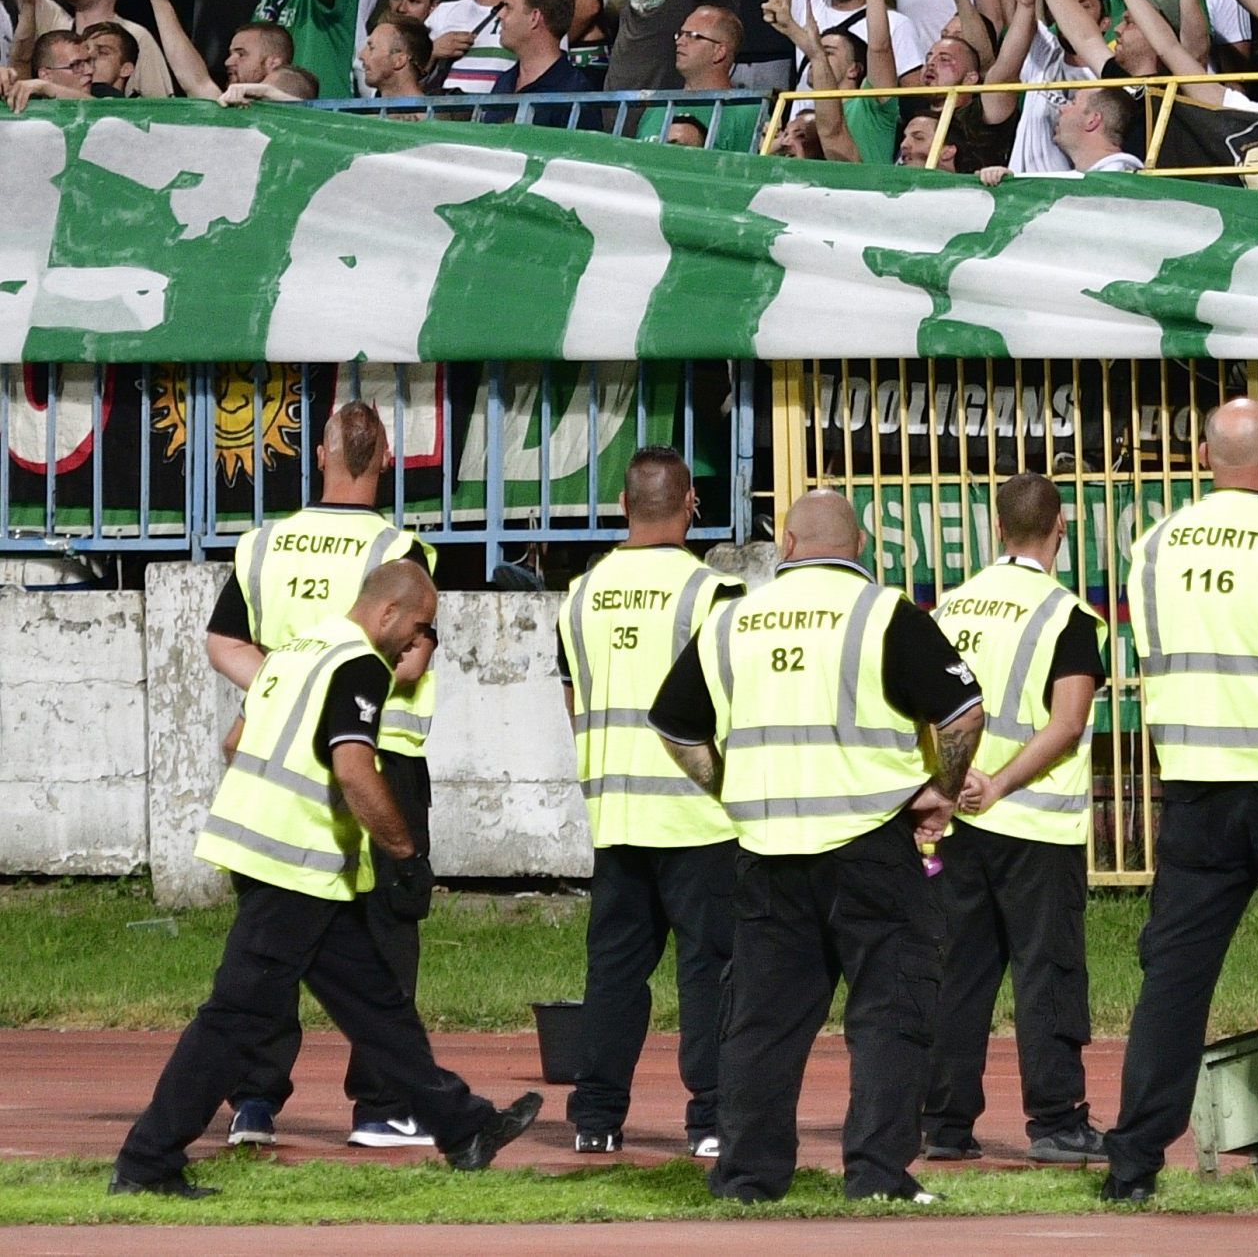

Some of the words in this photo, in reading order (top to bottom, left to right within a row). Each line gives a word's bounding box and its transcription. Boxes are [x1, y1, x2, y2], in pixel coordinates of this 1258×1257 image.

[272, 534, 368, 557] SECURITY
[286, 577, 330, 600] 123
[1181, 569, 1235, 594] 116
[592, 590, 672, 611] SECURITY
[737, 610, 844, 634] SECURITY
[612, 626, 638, 649] 35
[770, 646, 805, 672] 82
